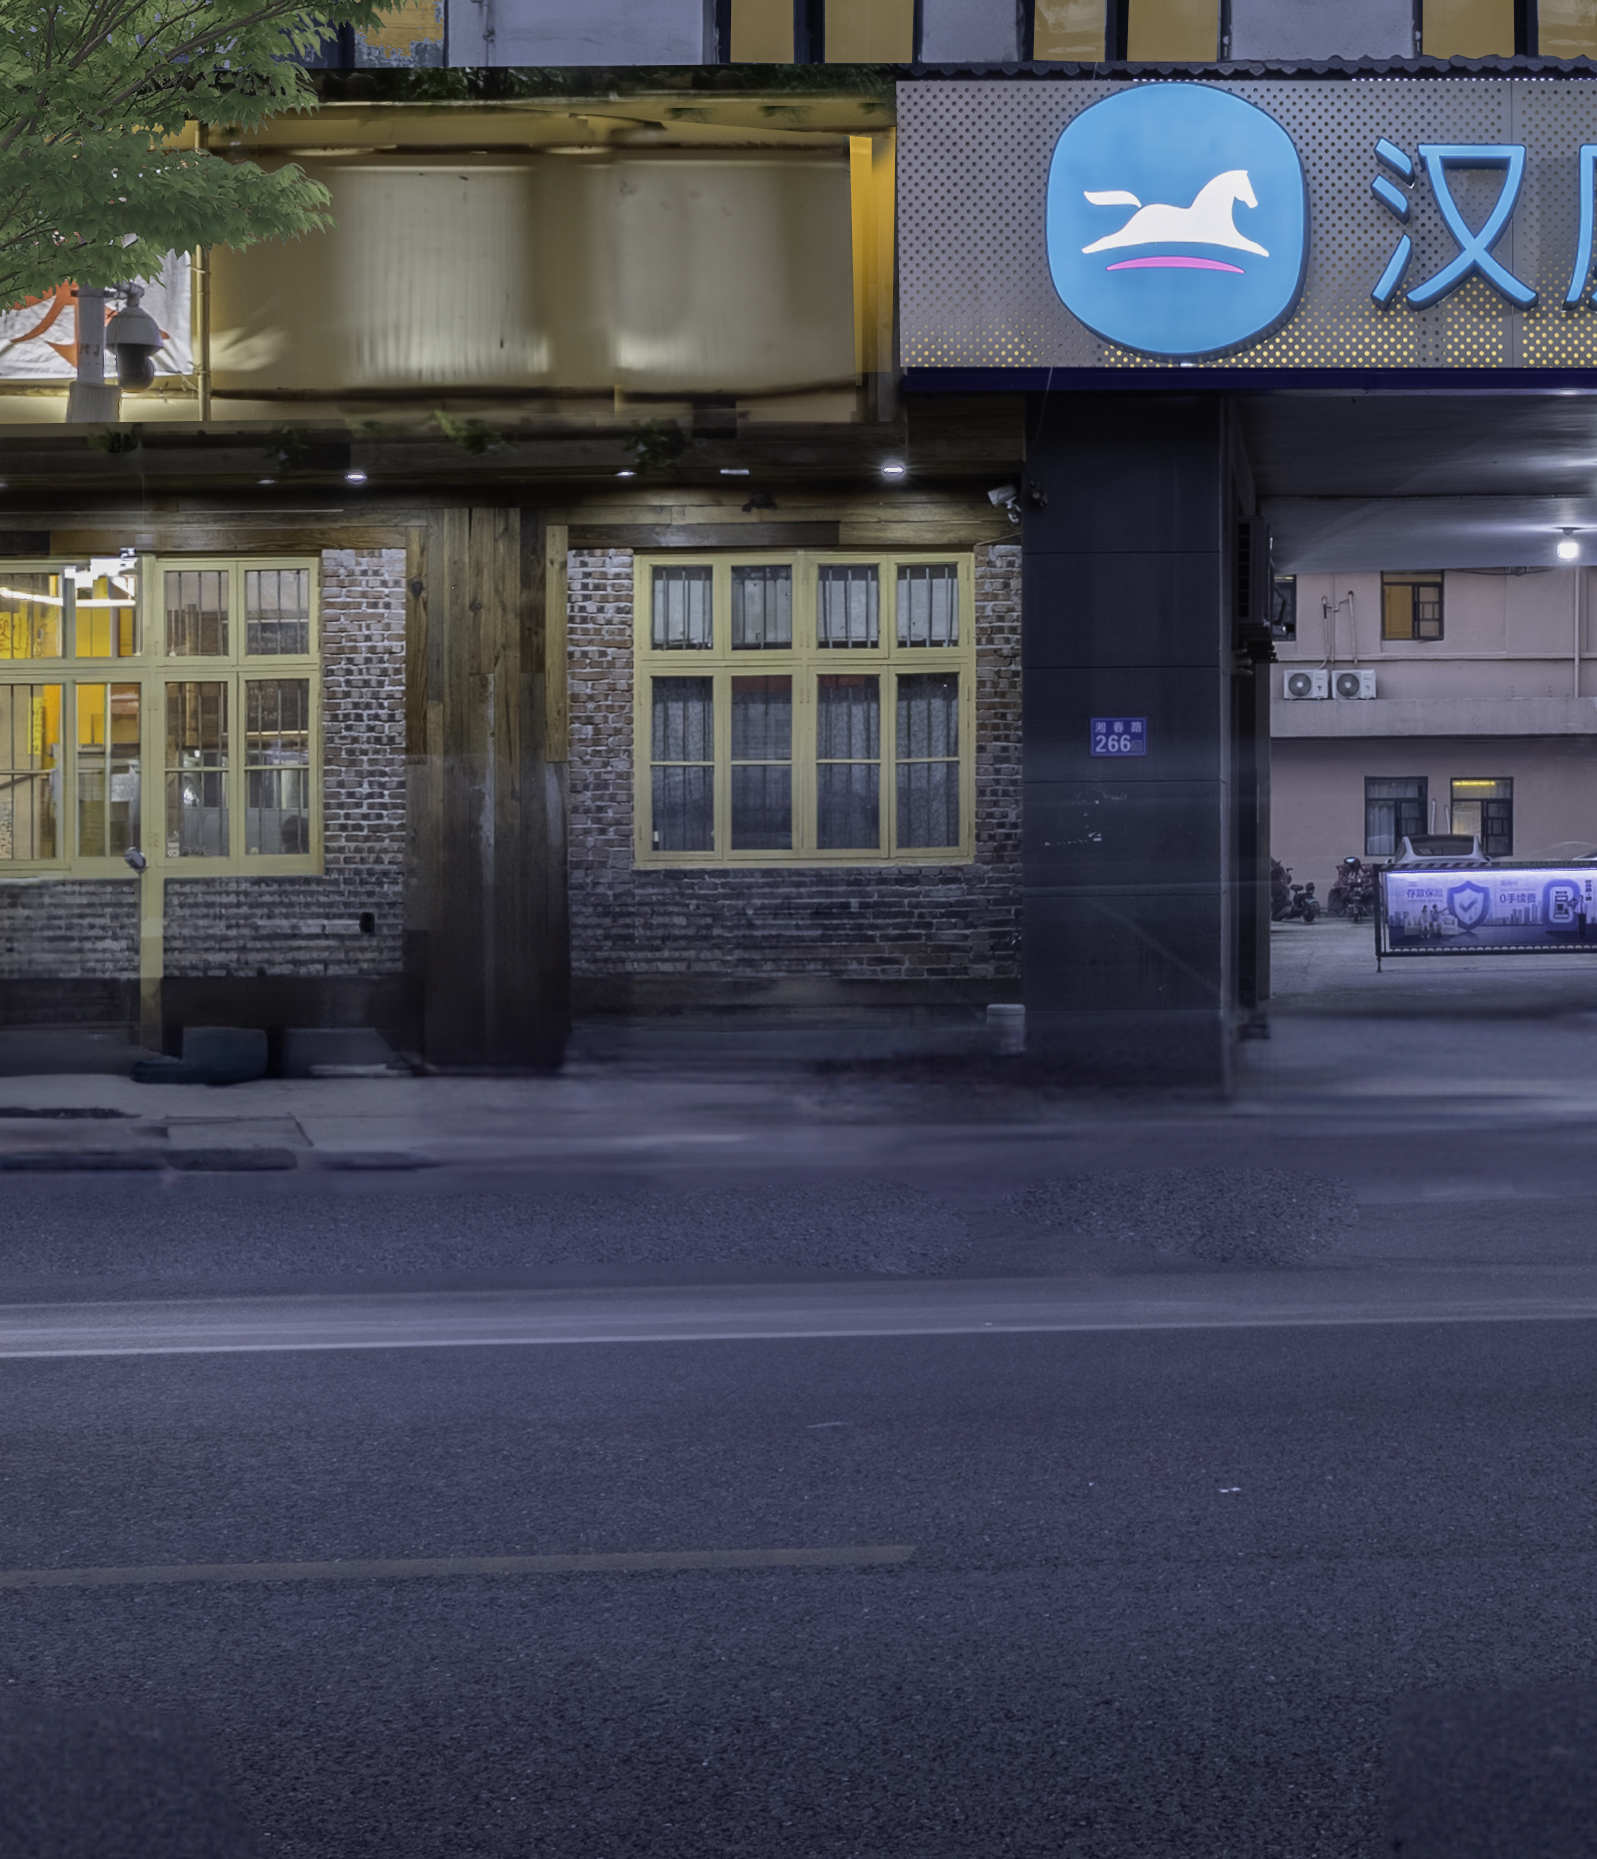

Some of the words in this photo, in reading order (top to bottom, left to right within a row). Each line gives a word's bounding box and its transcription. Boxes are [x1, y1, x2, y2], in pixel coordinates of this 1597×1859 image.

[1095, 721, 1142, 733] 湘春路
[1095, 735, 1131, 752] 266
[1499, 892, 1537, 904] 0手续费
